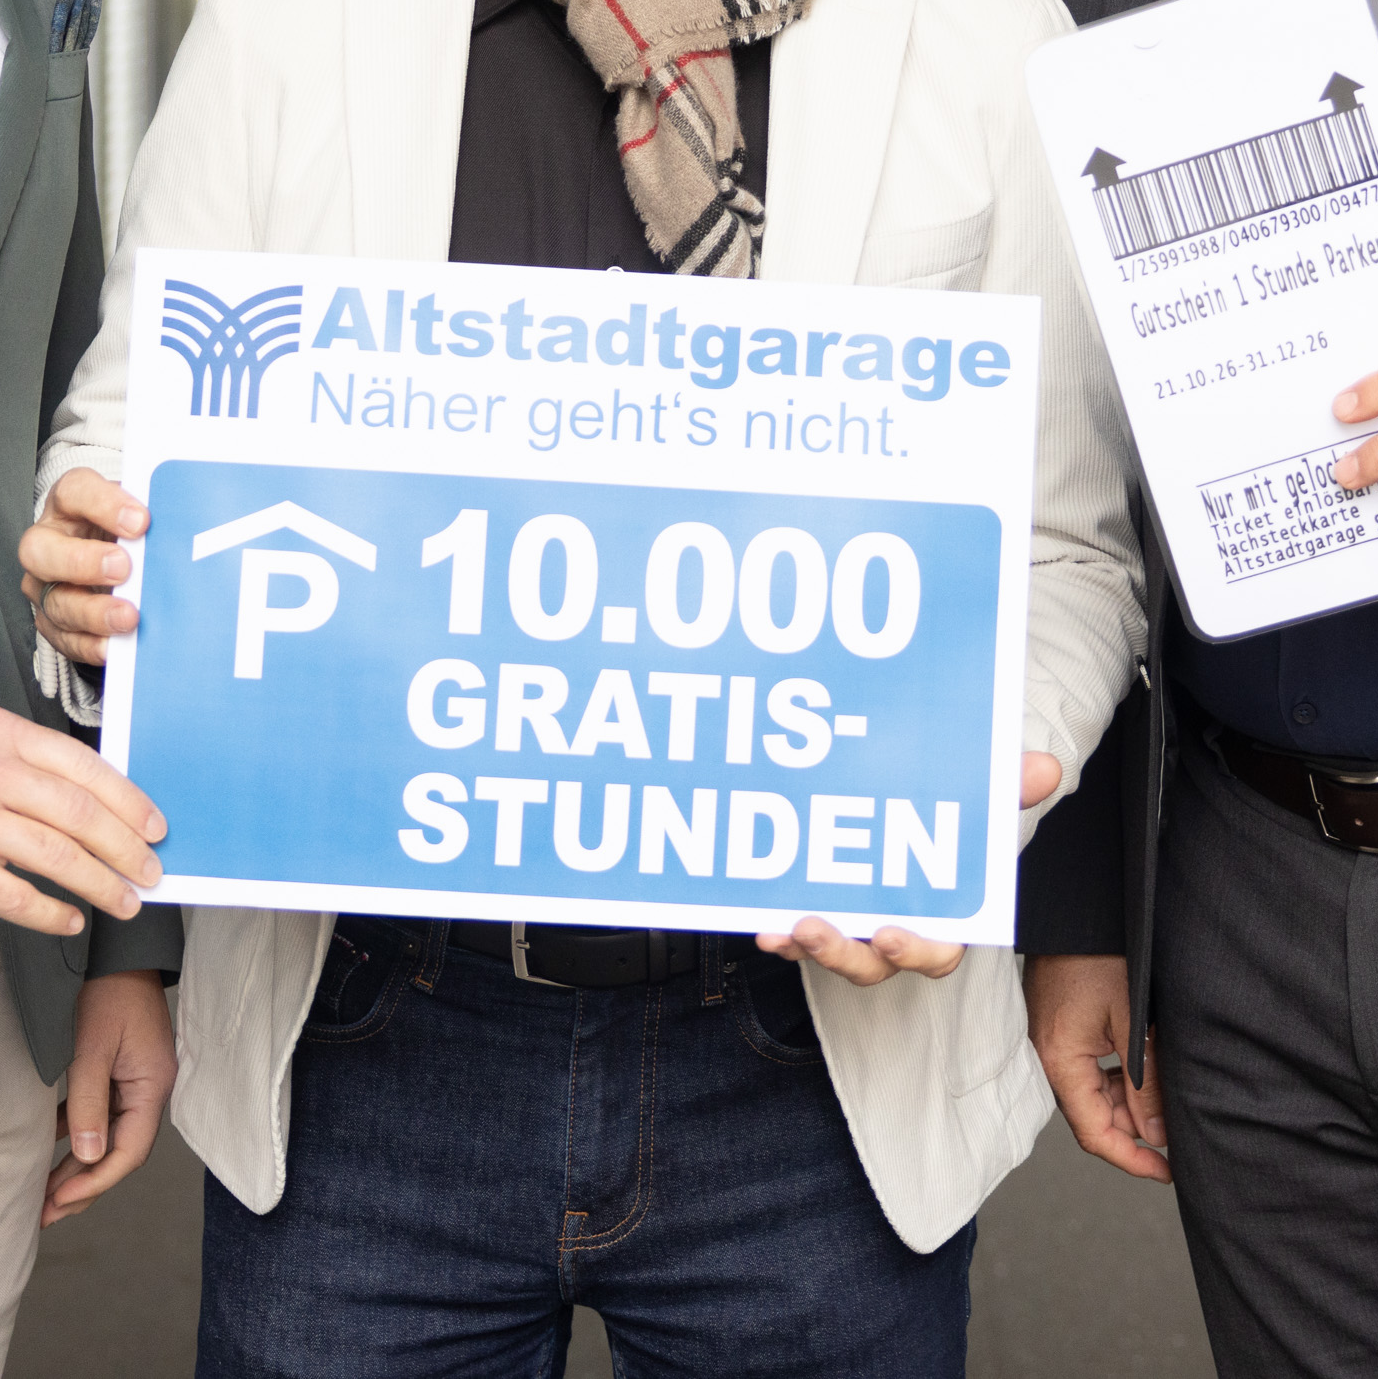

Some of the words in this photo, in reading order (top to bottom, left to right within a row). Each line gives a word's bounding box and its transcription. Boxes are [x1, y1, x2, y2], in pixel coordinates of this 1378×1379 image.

[1131, 281, 1227, 339] Gutschein
[1233, 274, 1249, 306] 1
[1252, 251, 1319, 300] Stunde
[311, 286, 1012, 400] Altstadtgarage
[1154, 331, 1329, 399] 21.10.26-31.12.26
[310, 372, 505, 435] Näher
[745, 402, 909, 458] nicht.
[1201, 490, 1234, 522] Nur
[1244, 474, 1277, 511] mit
[1211, 511, 1273, 541] Ticket
[1217, 505, 1361, 559] Nachsteckkarte
[421, 509, 921, 659] 10.000
[1224, 524, 1366, 577] Altstadtgarage
[406, 659, 868, 768] GRATIS-
[397, 773, 960, 890] STUNDEN
